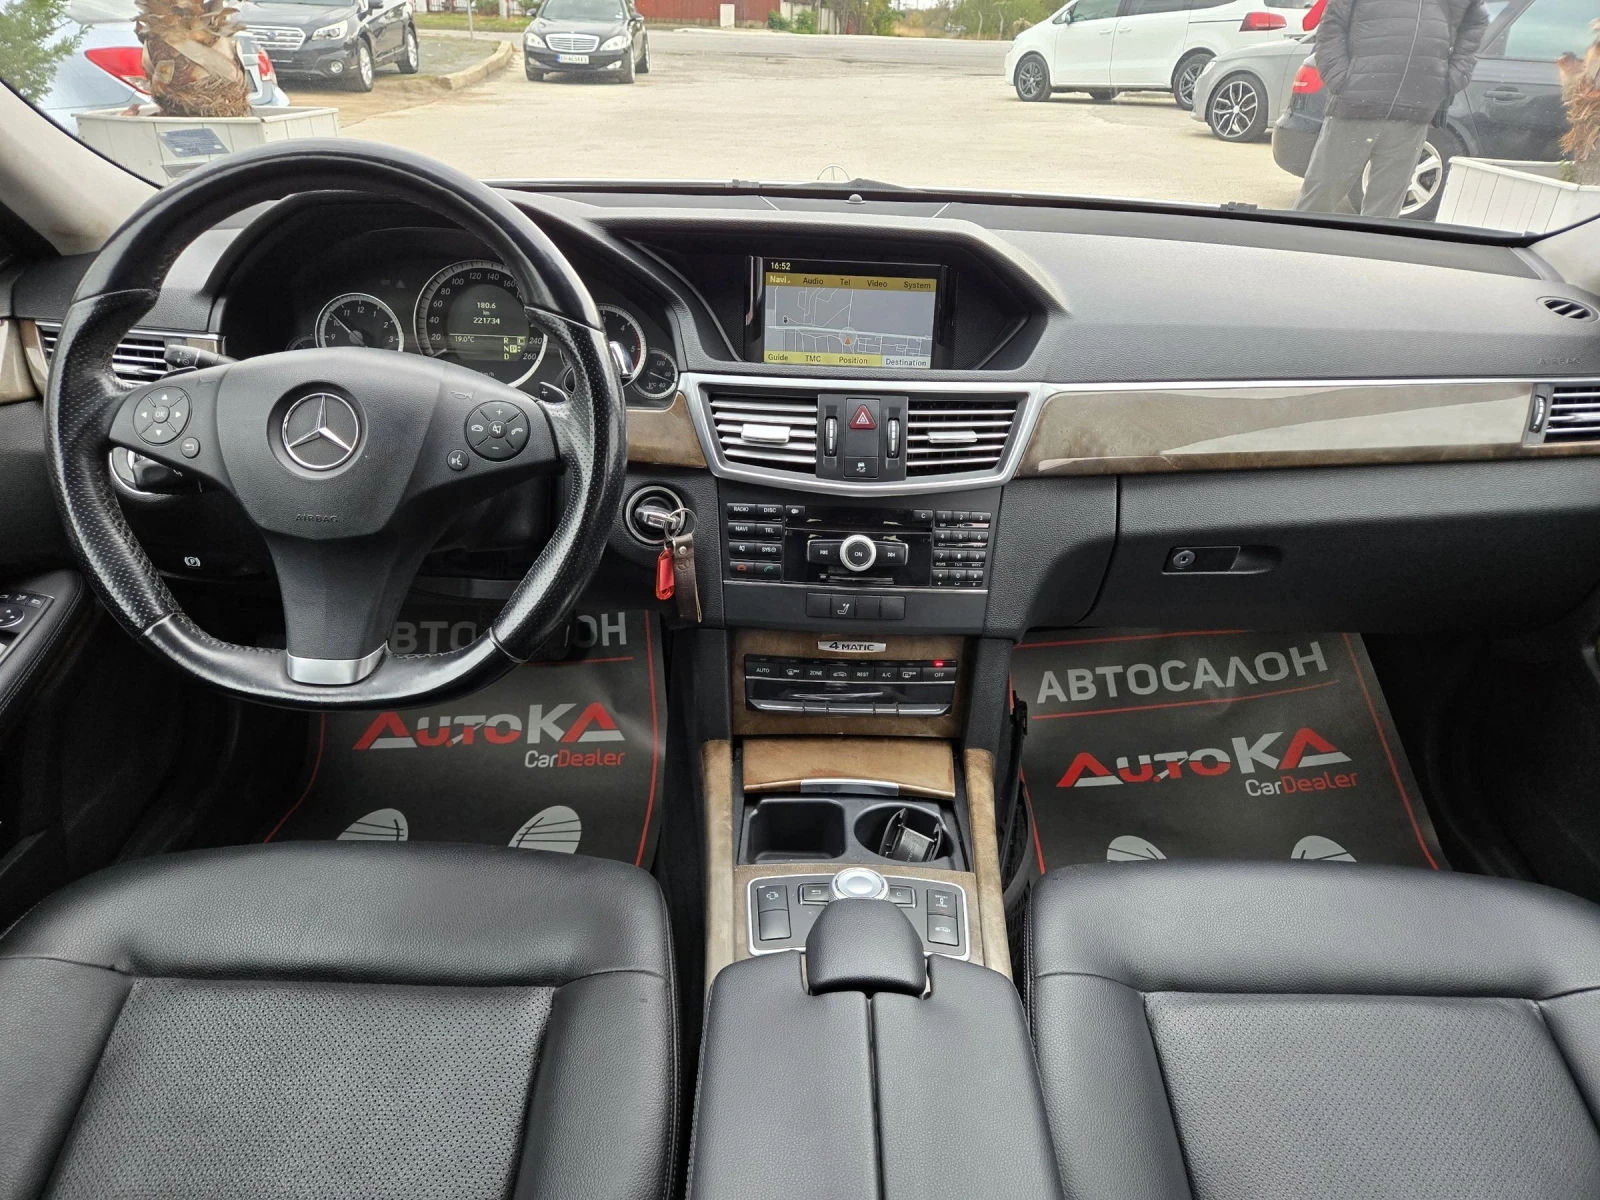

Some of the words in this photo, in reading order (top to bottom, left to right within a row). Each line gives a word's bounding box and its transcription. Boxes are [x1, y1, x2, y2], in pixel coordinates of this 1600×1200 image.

[770, 262, 791, 271] 16:52
[469, 272, 482, 280] 120
[770, 275, 787, 283] Navi
[803, 277, 824, 285] Audio
[840, 278, 850, 286] Tel
[867, 280, 888, 288] Video
[904, 281, 931, 290] System
[429, 316, 439, 324] 40
[767, 353, 788, 362] Guide
[805, 355, 821, 363] TMC
[839, 356, 868, 365] Position
[885, 358, 927, 367] Destination
[296, 513, 338, 523] AIRBAG
[1037, 641, 1328, 704] АВТОСАЛОН
[524, 748, 625, 768] CarDealer
[1245, 771, 1357, 797] CarDealer
